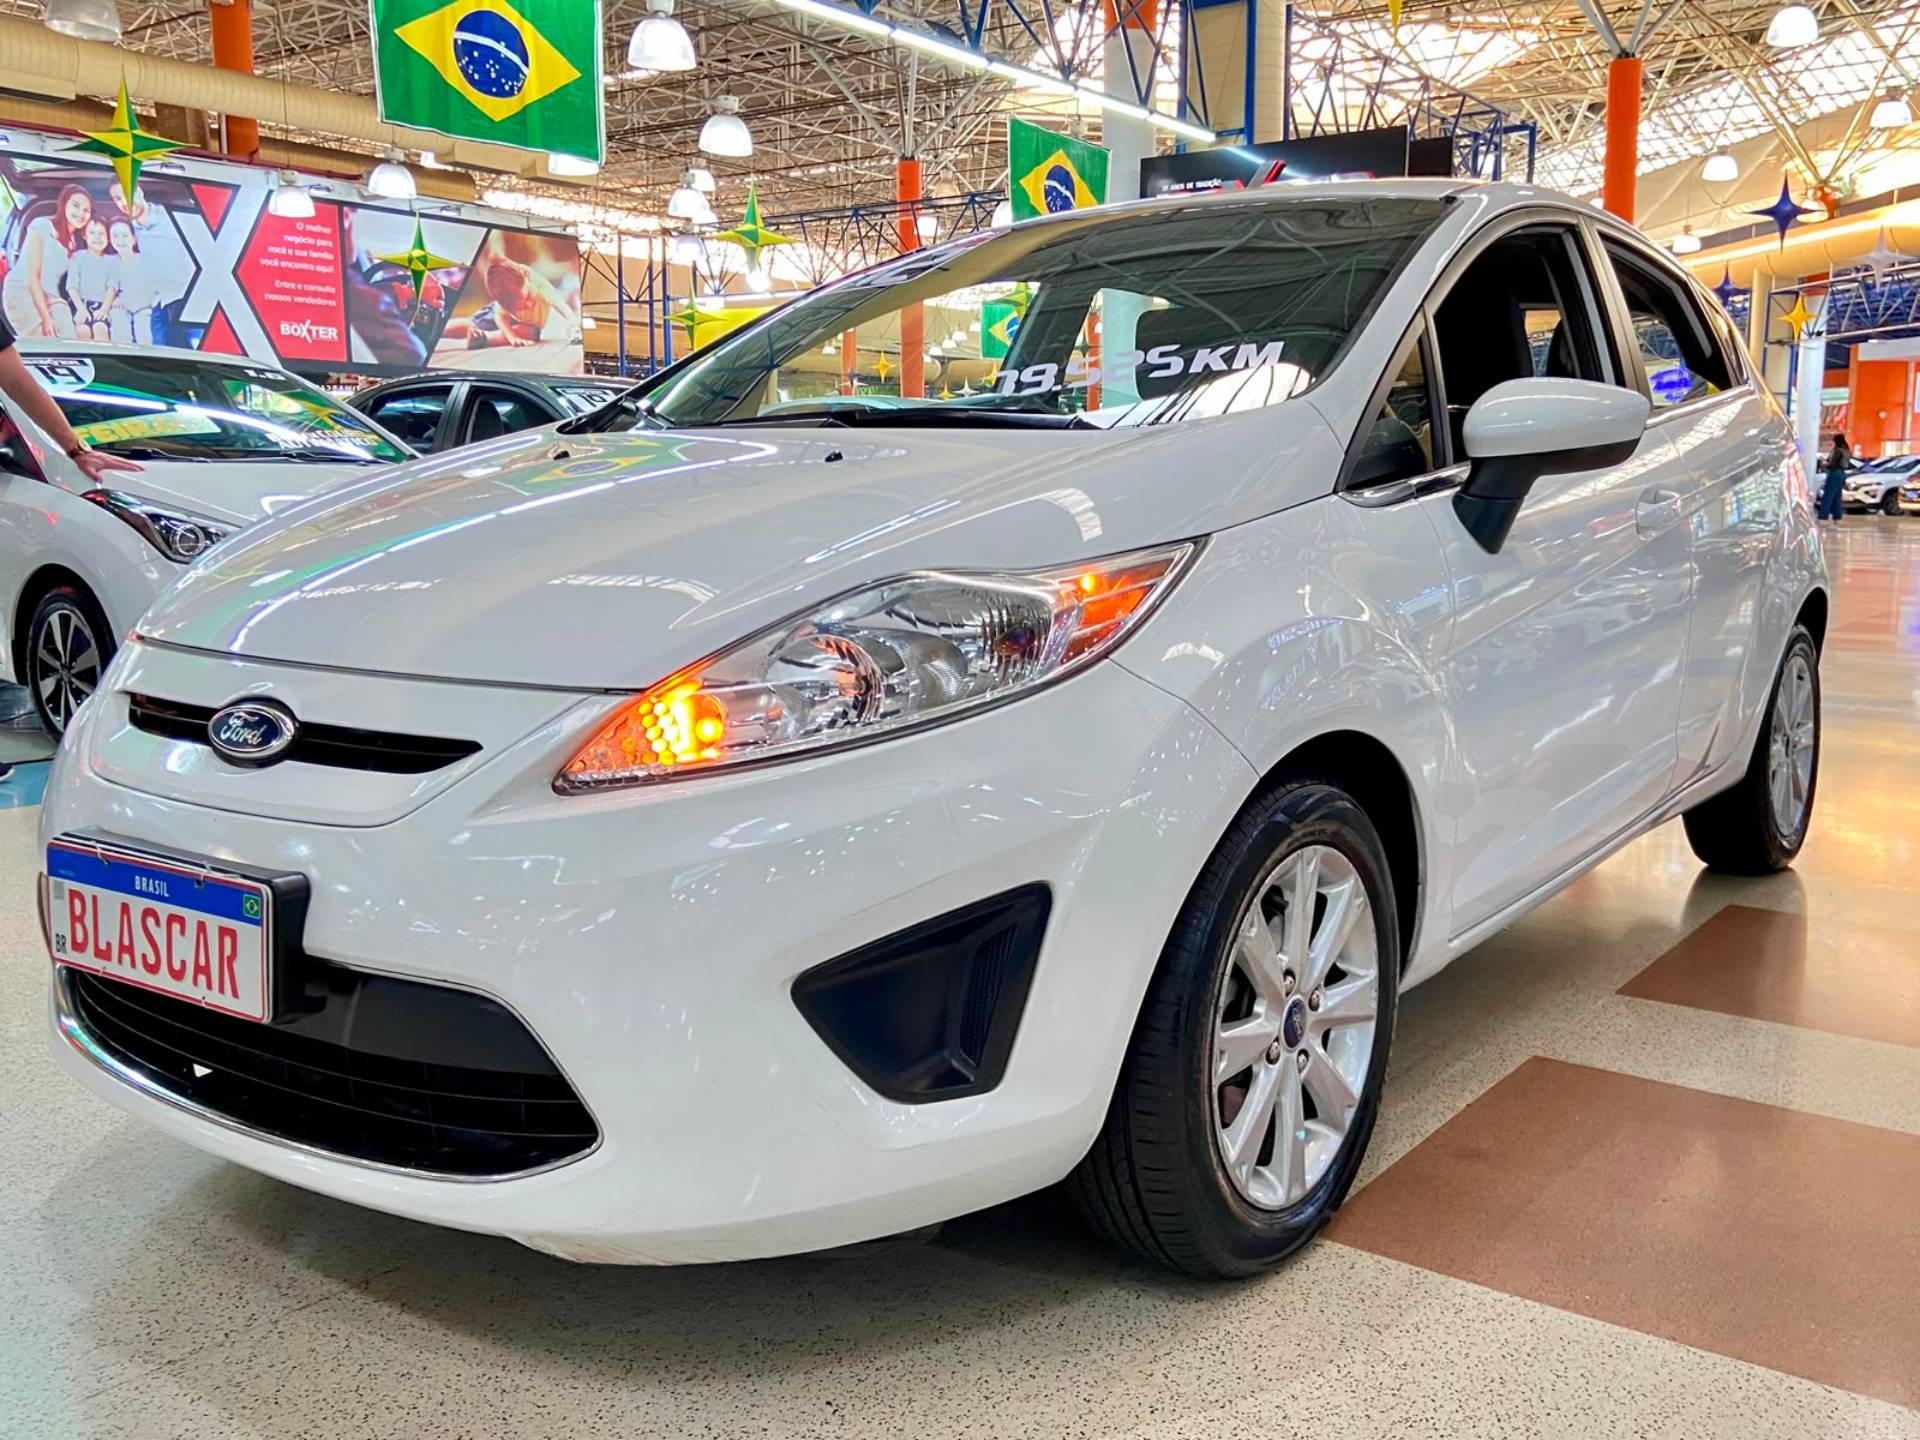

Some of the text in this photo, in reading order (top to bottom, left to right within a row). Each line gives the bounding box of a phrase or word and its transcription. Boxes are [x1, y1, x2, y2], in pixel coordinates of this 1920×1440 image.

[296, 222, 332, 234] O melhor
[267, 245, 287, 255] você
[288, 248, 293, 256] e
[294, 249, 308, 257] sua
[284, 235, 333, 248] negócio para
[259, 258, 279, 267] você
[280, 261, 315, 271] encontra
[275, 279, 295, 290] Entre
[264, 293, 337, 307] nossos vendedores
[280, 319, 339, 344] BOXTER
[1188, 341, 1285, 374] KM
[34, 364, 86, 385] 19
[221, 711, 268, 745] Ford
[134, 876, 169, 897] BRASIL
[55, 933, 67, 954] BR
[68, 888, 239, 999] BLASCAR
